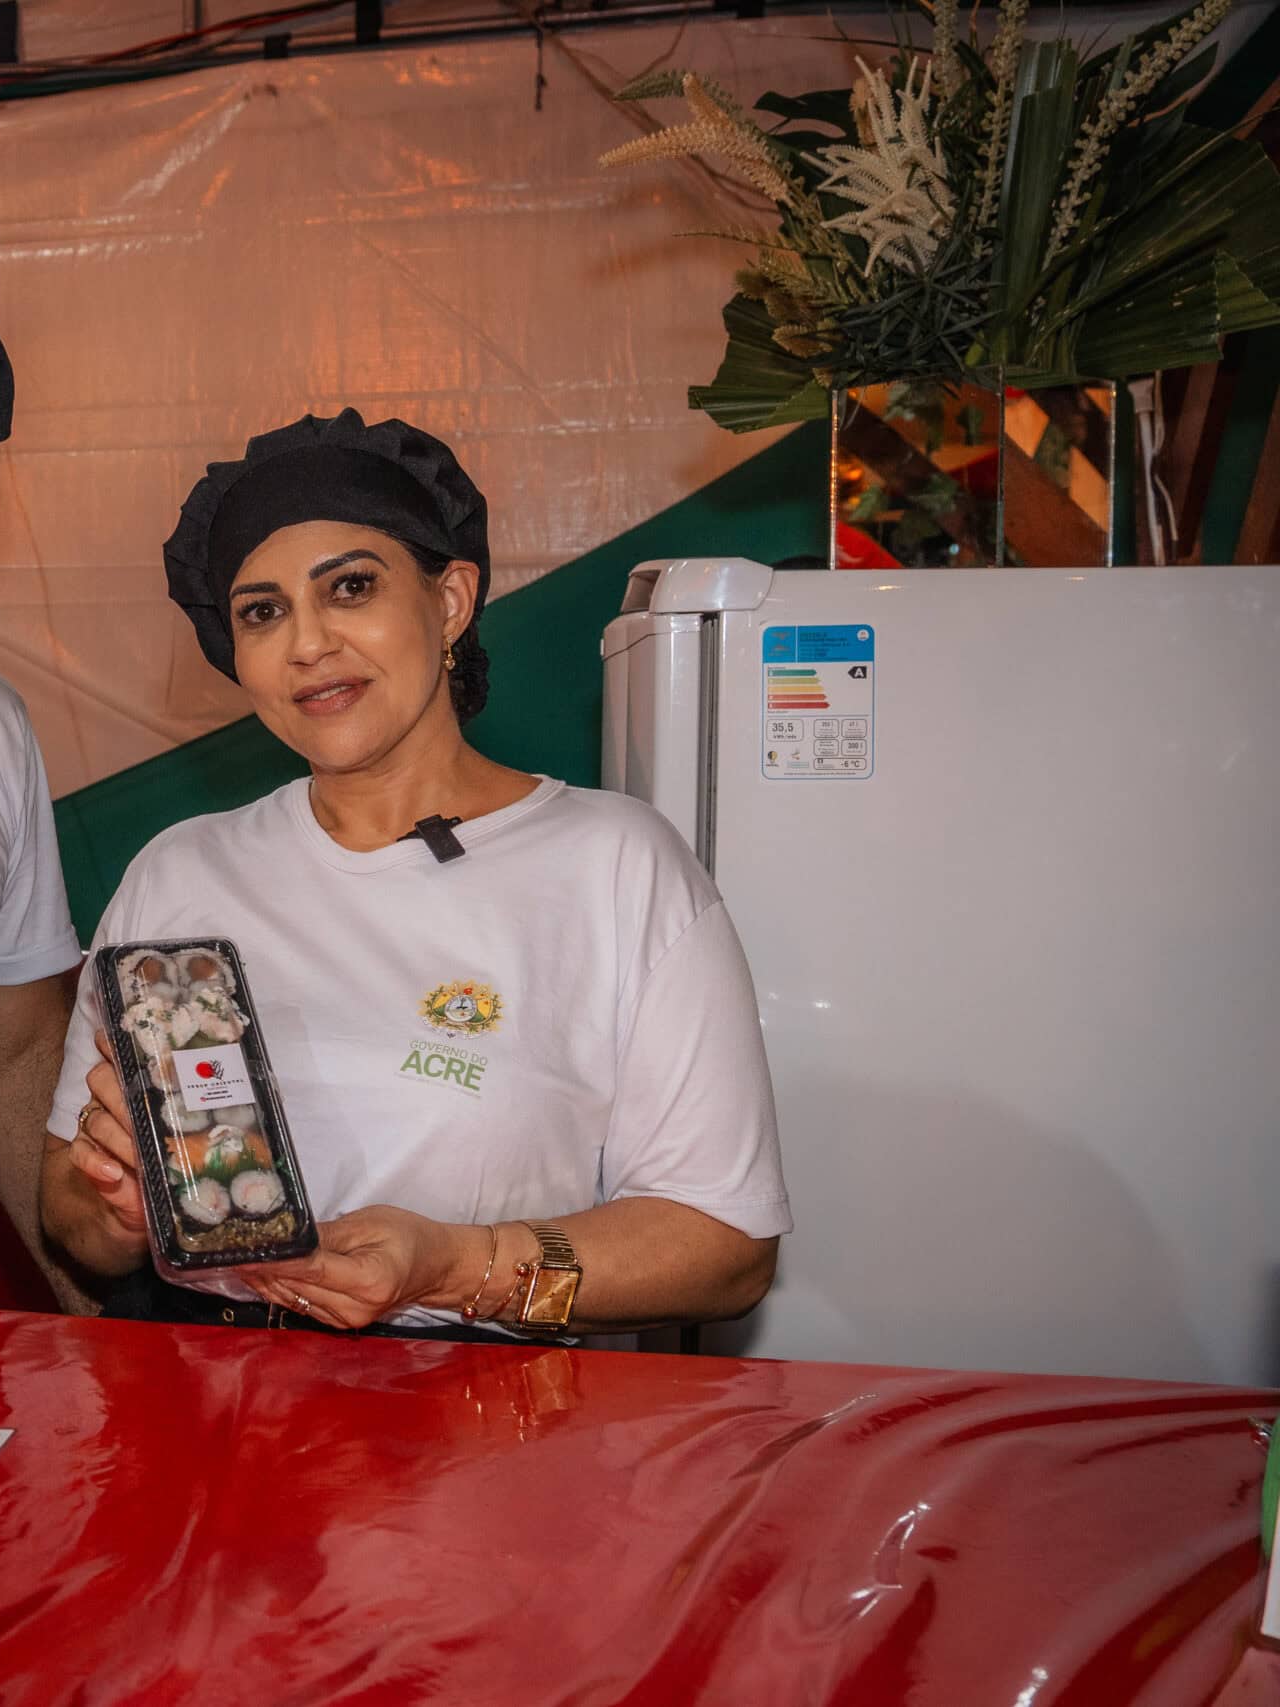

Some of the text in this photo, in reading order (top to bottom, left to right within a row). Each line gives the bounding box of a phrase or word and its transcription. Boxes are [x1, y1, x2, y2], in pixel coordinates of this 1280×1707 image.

[854, 667, 864, 677] A
[772, 722, 794, 733] 35,5
[410, 1040, 488, 1066] GOVERNO DO
[400, 1050, 485, 1091] ACRE
